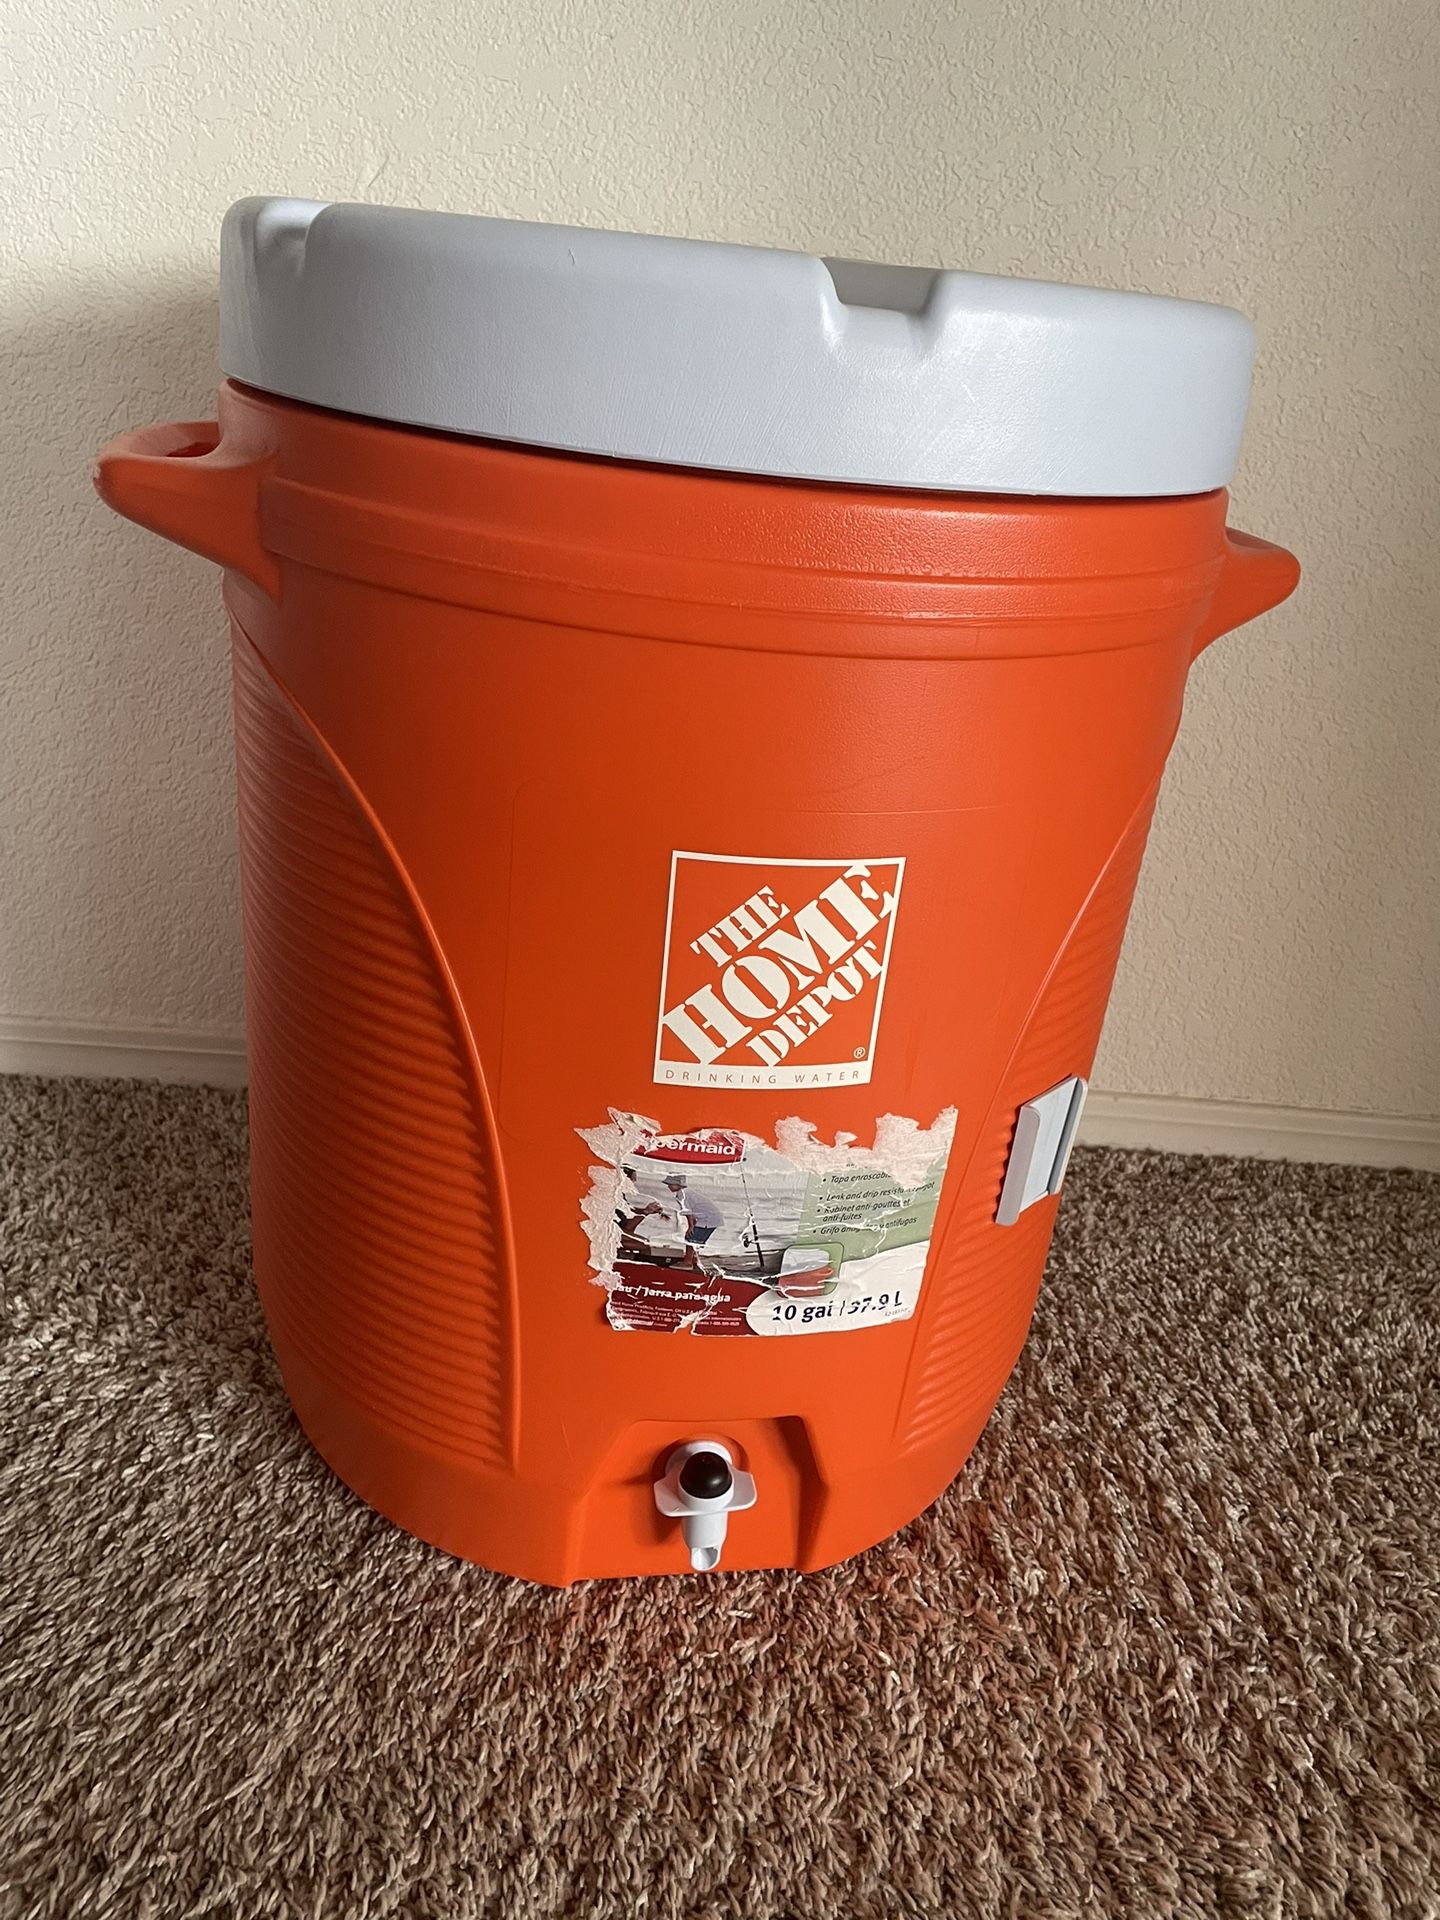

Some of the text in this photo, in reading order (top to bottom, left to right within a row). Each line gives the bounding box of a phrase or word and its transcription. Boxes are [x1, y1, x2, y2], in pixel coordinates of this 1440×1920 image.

[689, 885, 791, 968] THE
[660, 864, 896, 1066] HOME
[746, 939, 884, 1067] DEPOT
[665, 1069, 860, 1084] DRINKING WATER
[831, 1175, 849, 1184] Tapa
[826, 1193, 845, 1202] Leak
[845, 1191, 861, 1200] and
[862, 1190, 879, 1201] drip
[820, 1225, 840, 1235] Grifo
[675, 1290, 703, 1302] para
[772, 1304, 797, 1321] 10
